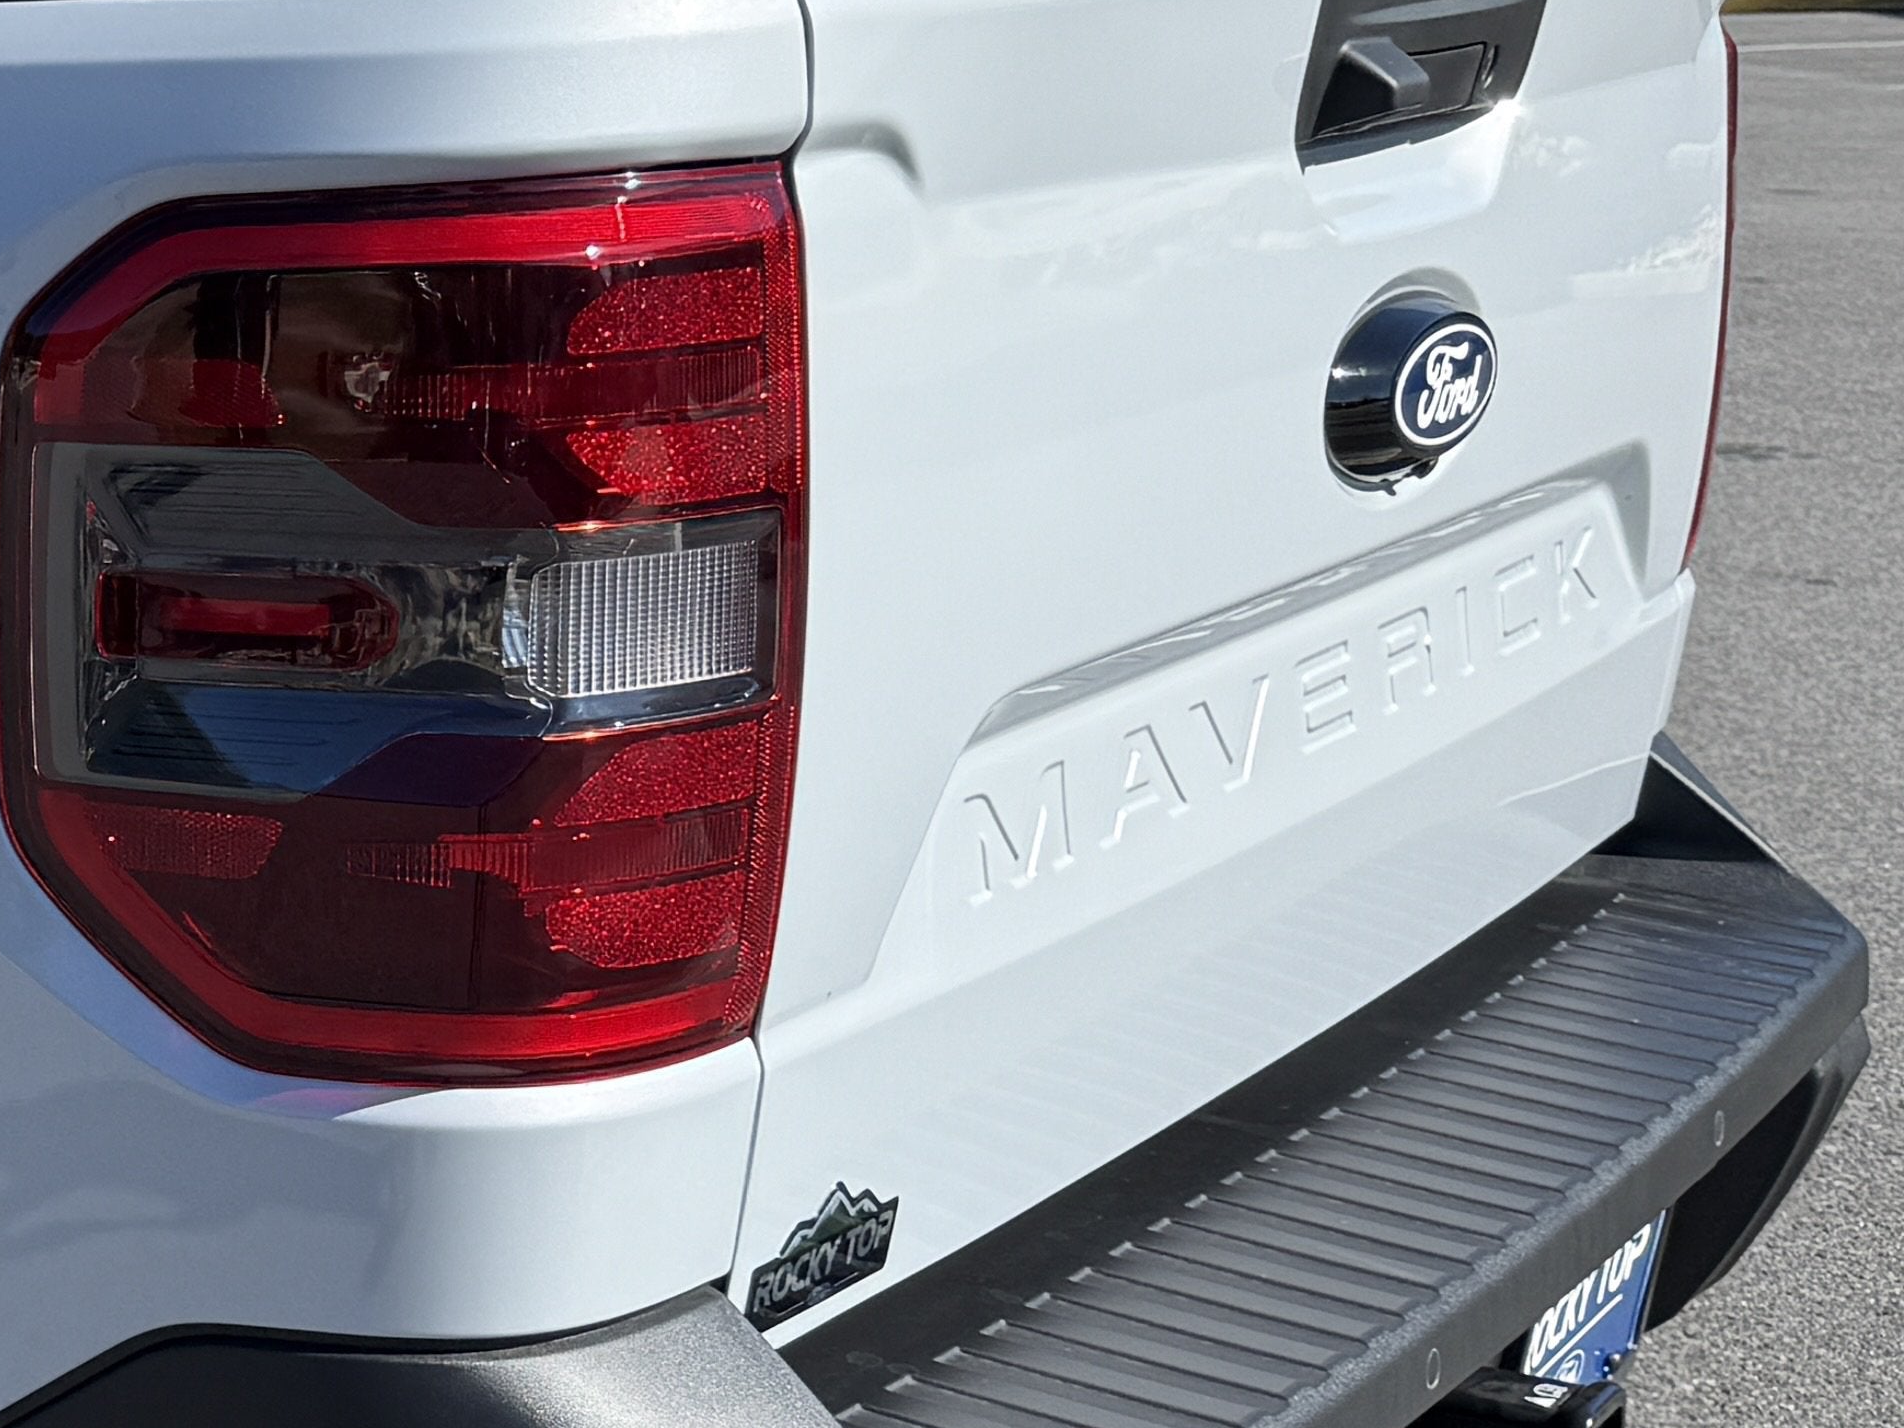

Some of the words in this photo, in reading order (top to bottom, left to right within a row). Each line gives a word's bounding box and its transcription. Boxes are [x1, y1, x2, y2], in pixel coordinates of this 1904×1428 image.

[1417, 341, 1483, 429] Ford
[963, 526, 1600, 907] MAVERICK
[752, 1235, 842, 1314] ROCKY
[846, 1209, 894, 1266] TOP
